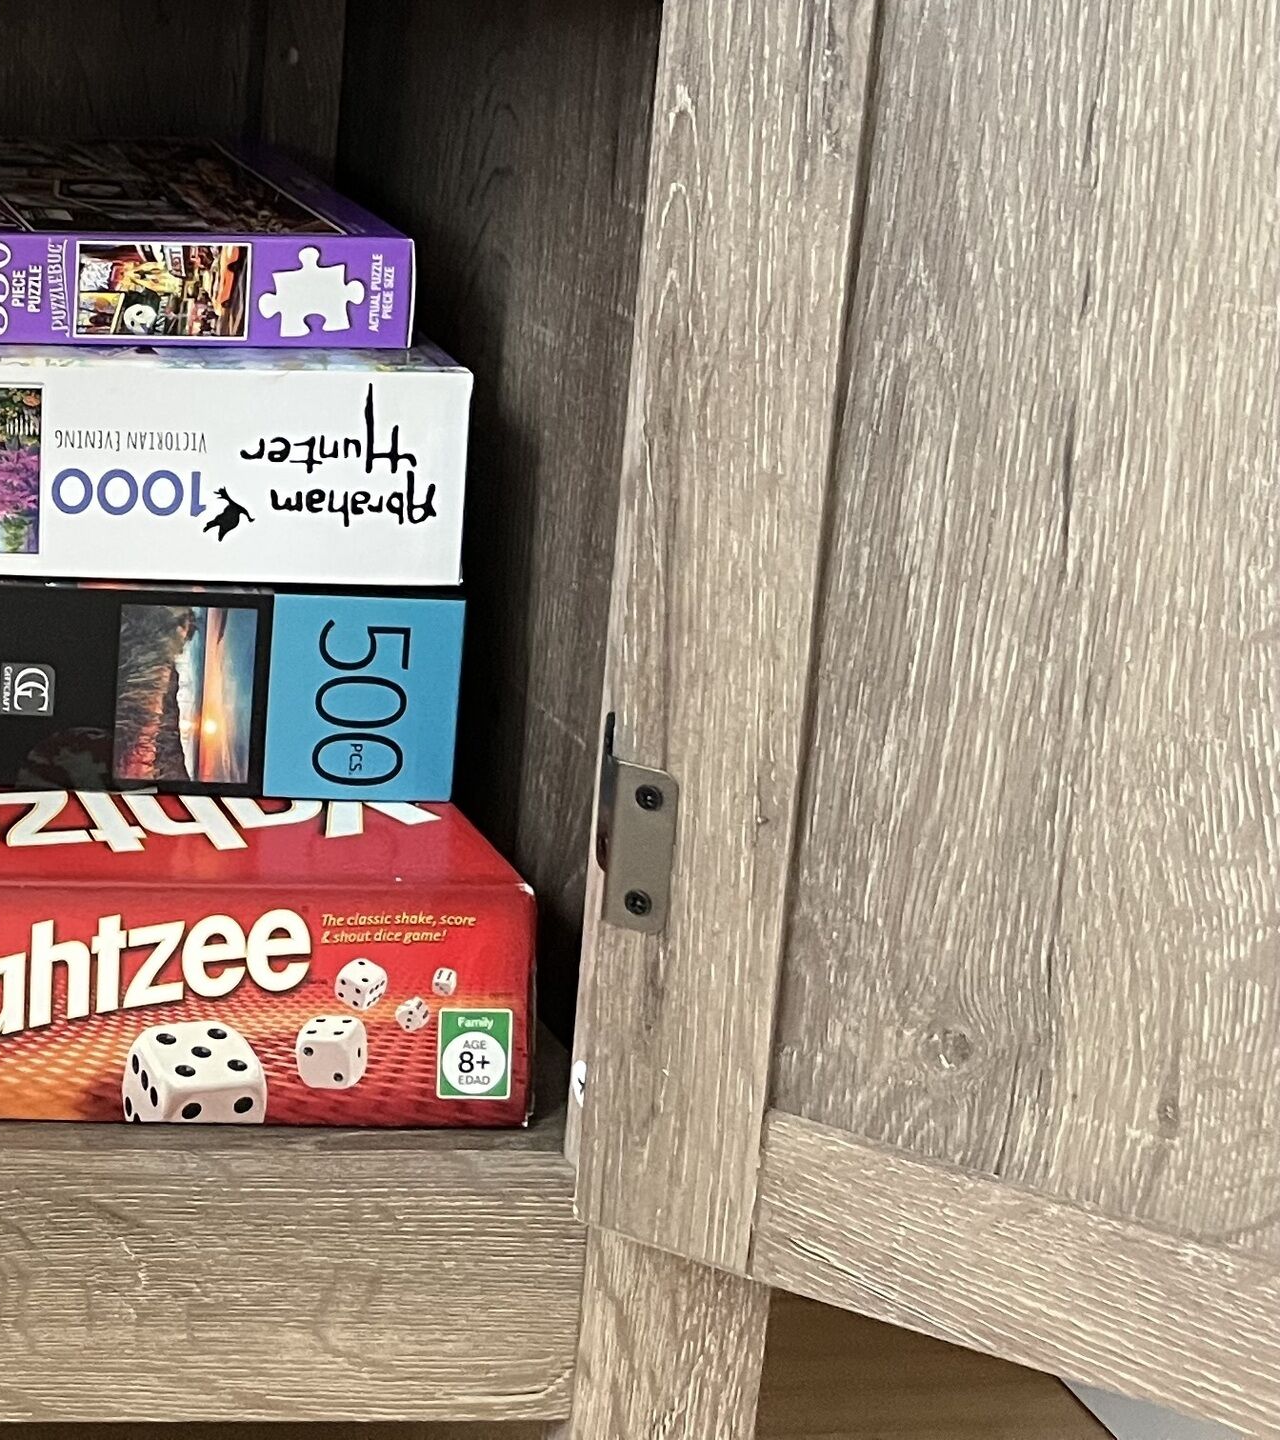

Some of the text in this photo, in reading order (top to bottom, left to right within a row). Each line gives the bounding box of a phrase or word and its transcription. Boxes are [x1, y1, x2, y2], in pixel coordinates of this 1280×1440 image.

[11, 269, 27, 308] PIECE
[27, 264, 43, 313] PUZZLE
[46, 243, 69, 331] PUZZLEBUG
[367, 253, 383, 333] ACTUAL PUZZLE
[380, 266, 395, 320] PIECE SIZE
[54, 428, 208, 453] VICTORIAN EVENING
[240, 383, 419, 476] Hunter
[52, 467, 207, 519] 1000
[271, 471, 438, 527] Abraham
[311, 618, 413, 788] 500
[350, 743, 365, 776] PCS.
[320, 930, 447, 946] & shout dice game!
[321, 912, 477, 930] The classic shake, score
[456, 1016, 494, 1030] Family
[458, 1051, 491, 1074] 8+
[462, 1039, 488, 1050] AGE
[458, 1075, 491, 1086] EDAD
